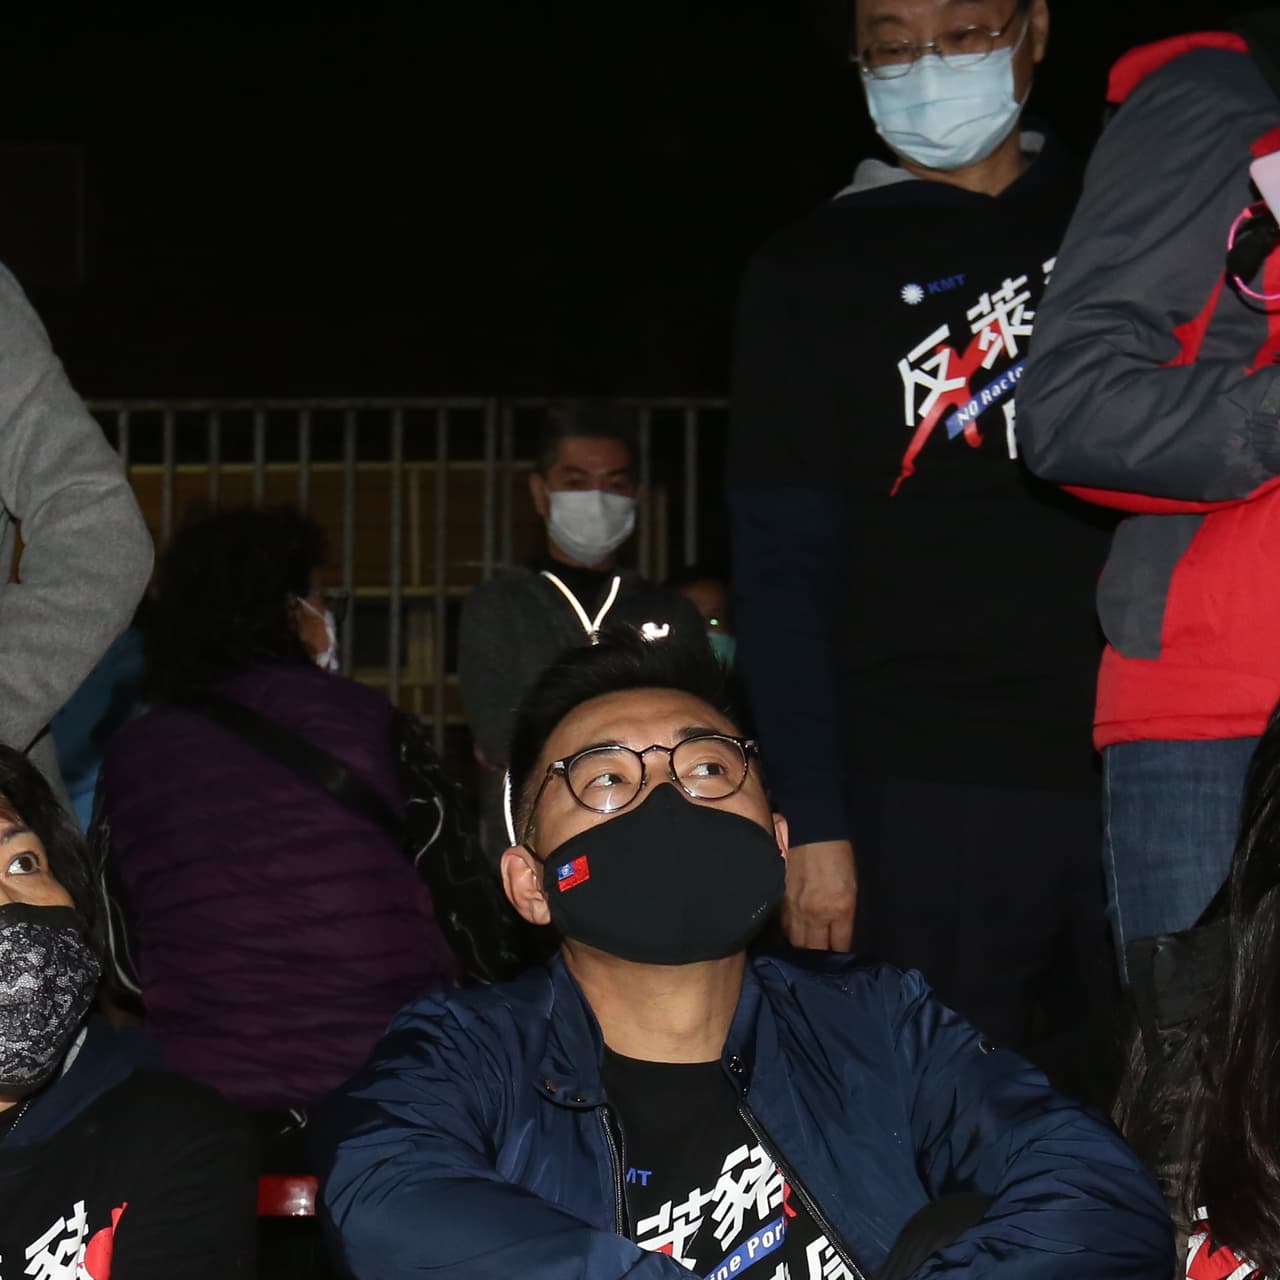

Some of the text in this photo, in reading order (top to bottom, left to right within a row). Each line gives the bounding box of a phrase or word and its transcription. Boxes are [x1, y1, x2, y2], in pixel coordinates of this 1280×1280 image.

[927, 273, 967, 294] KMT
[897, 257, 1057, 427] 反萊
[956, 400, 979, 427] NO
[746, 1219, 785, 1259] Por
